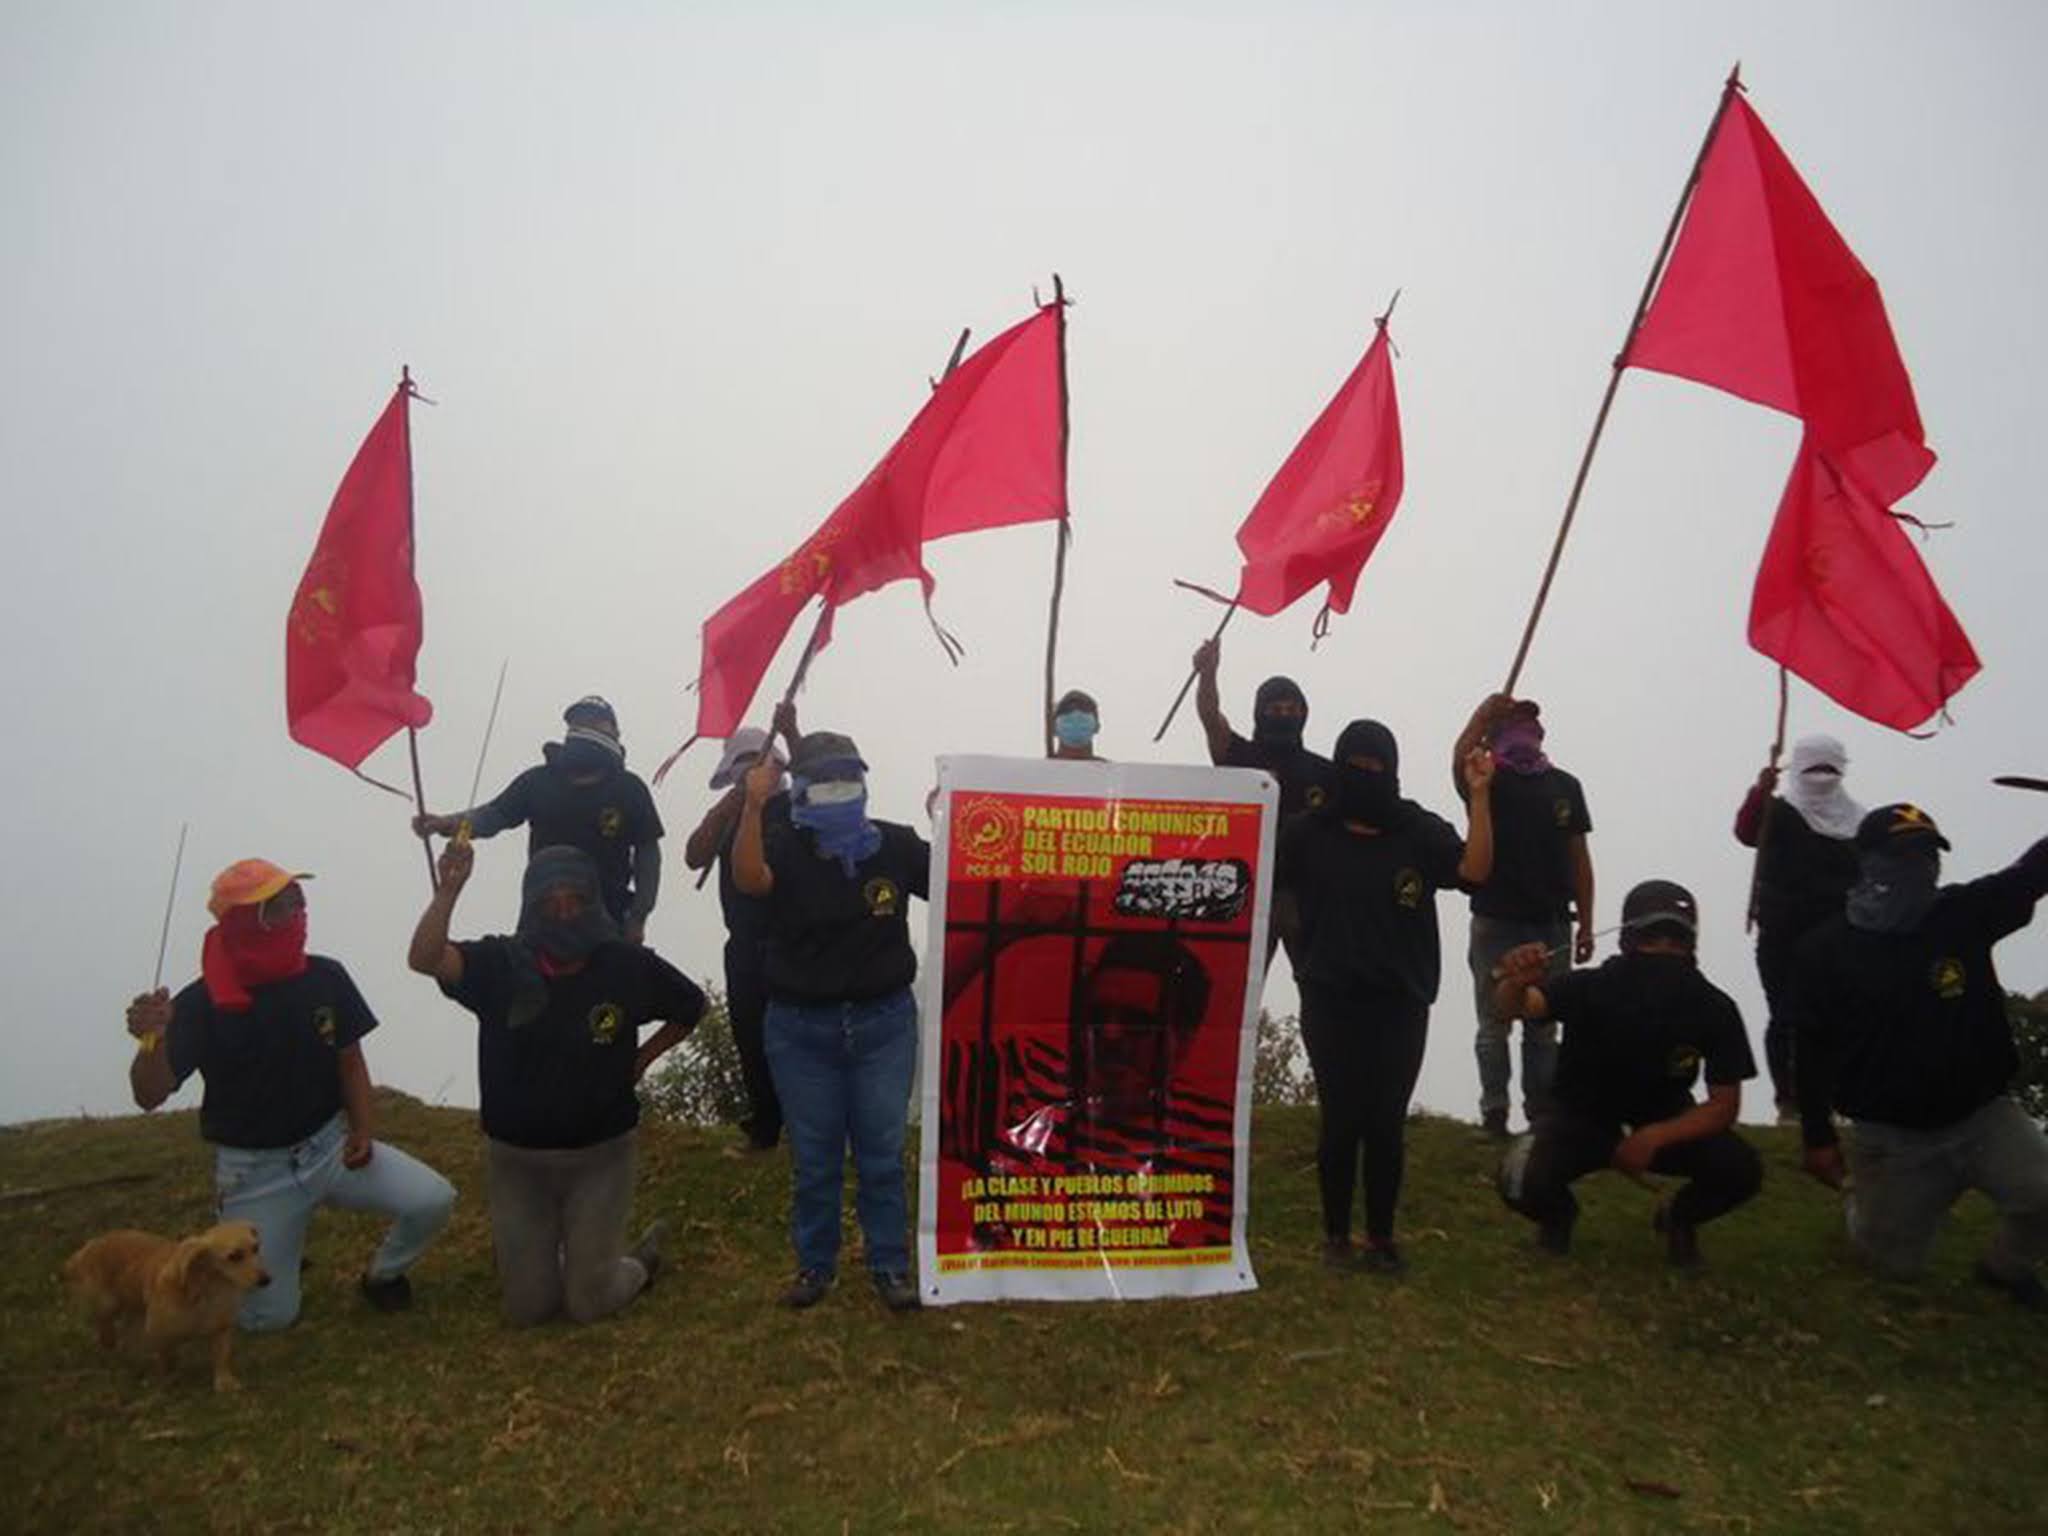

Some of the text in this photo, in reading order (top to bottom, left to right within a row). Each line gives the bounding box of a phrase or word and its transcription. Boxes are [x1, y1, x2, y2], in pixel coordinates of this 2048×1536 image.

[1023, 806, 1109, 831] PARTIDO
[1113, 810, 1229, 838] COMUNISTA
[1024, 830, 1152, 857] DEL ECUADOR
[1021, 852, 1112, 878] SOL ROJO
[987, 1176, 1038, 1196] CLASE
[1040, 1177, 1052, 1196] Y
[1054, 1174, 1124, 1195] PUEBLOS
[974, 1199, 1204, 1223] DEL MUNDO ESTAMOS DE LUTO
[1011, 1225, 1170, 1248] Y EN PIE DE GUERRA!
